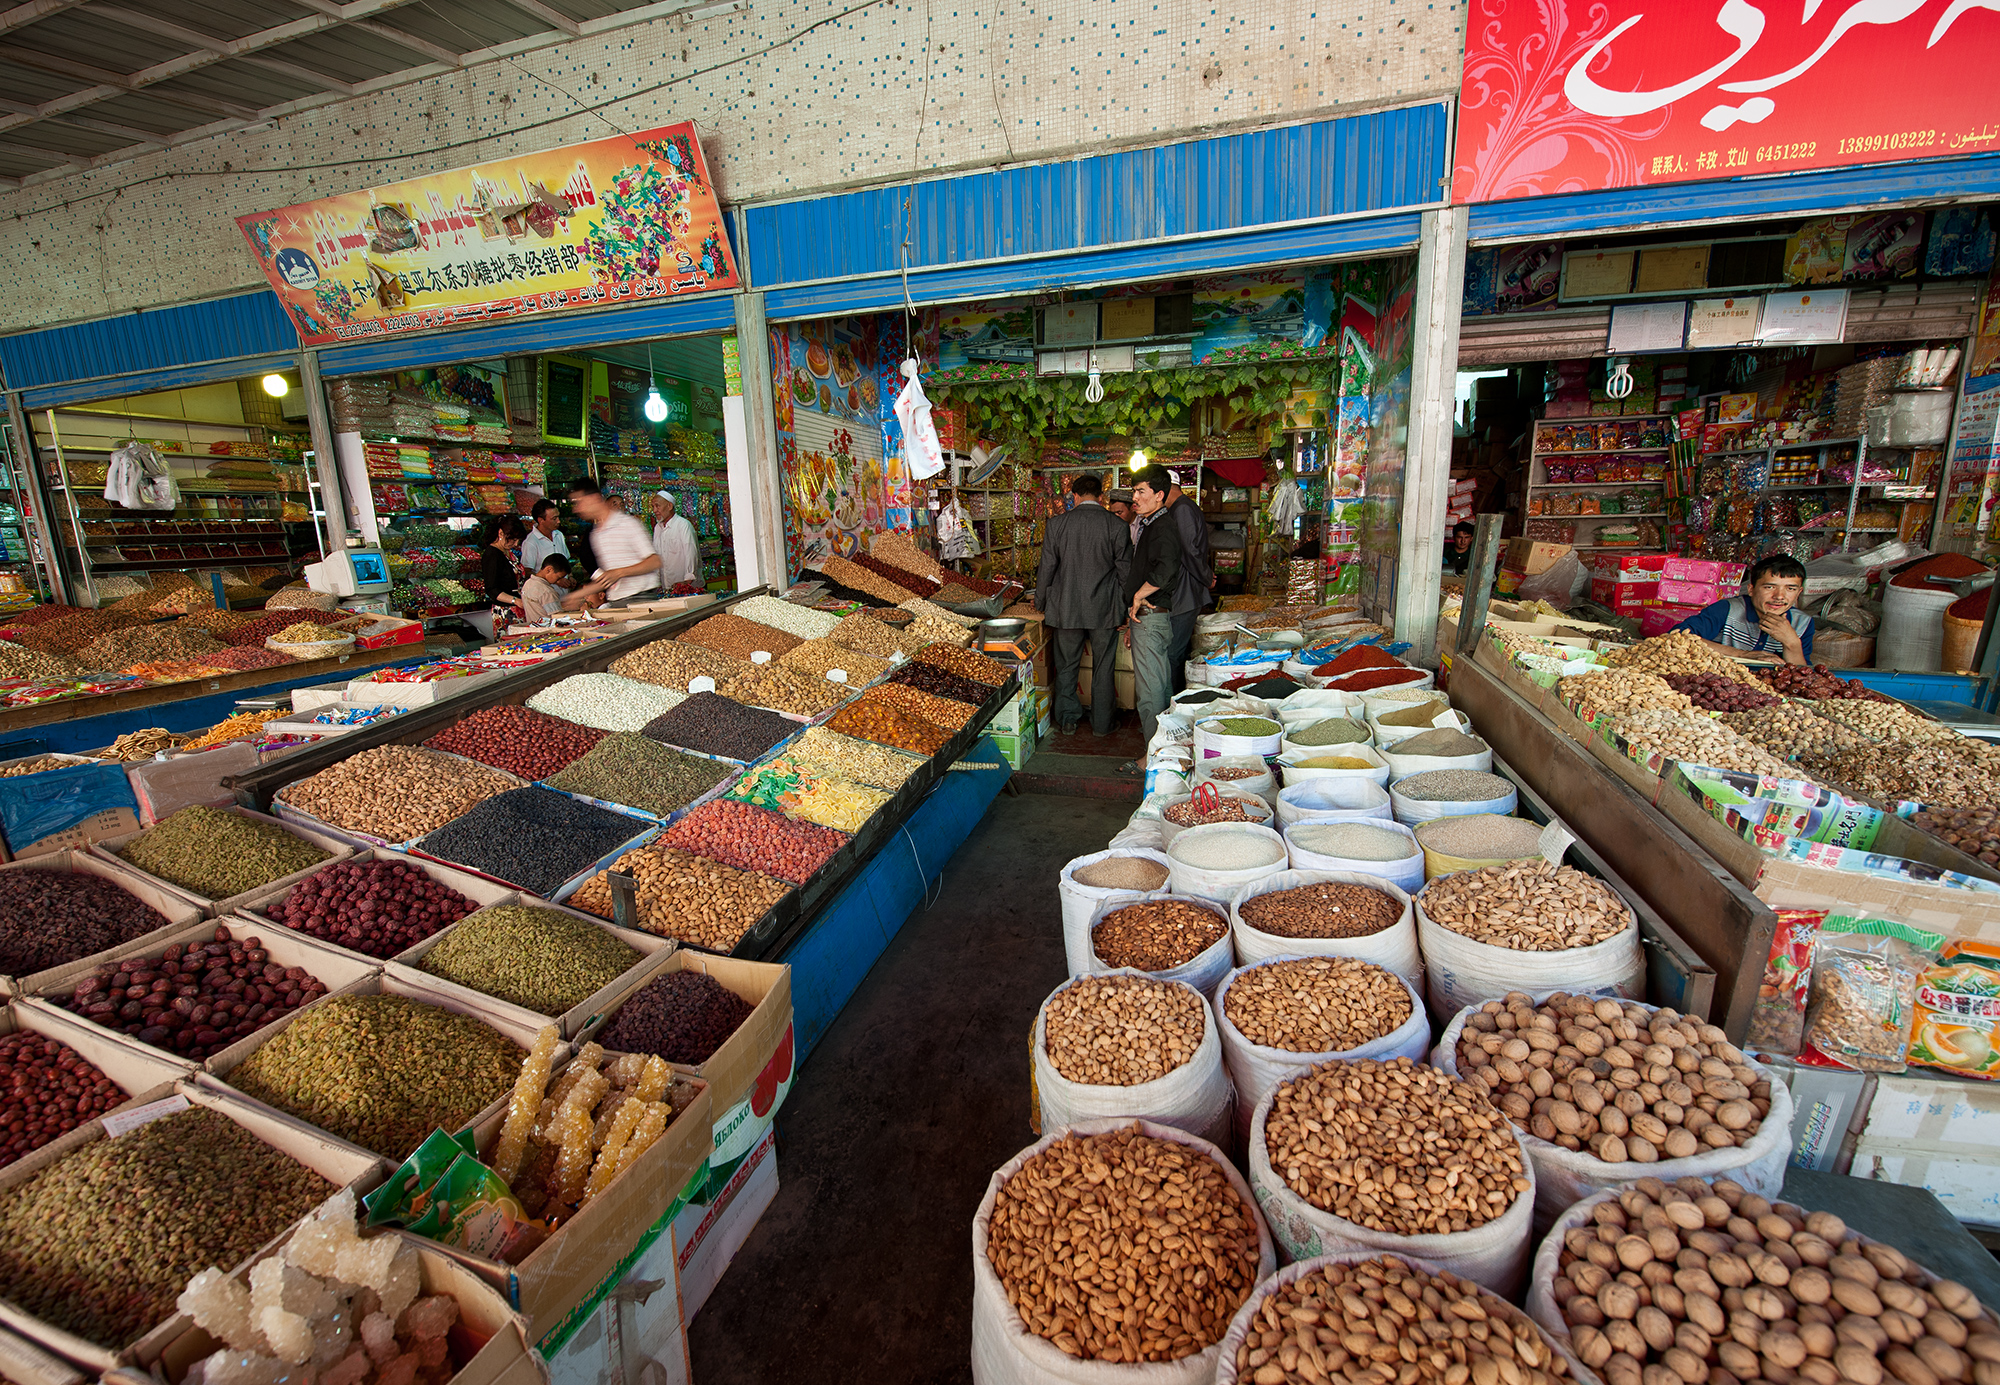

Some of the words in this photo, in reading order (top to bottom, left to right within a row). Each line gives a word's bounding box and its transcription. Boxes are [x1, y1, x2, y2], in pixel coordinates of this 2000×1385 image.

[1756, 142, 1817, 163] 6451222
[1837, 129, 1936, 155] 13899103222
[385, 314, 421, 332] 2224403
[1965, 448, 1972, 456] 2
[1975, 447, 1981, 455] 3
[1963, 461, 1968, 469] 8
[1972, 460, 1978, 468] 9
